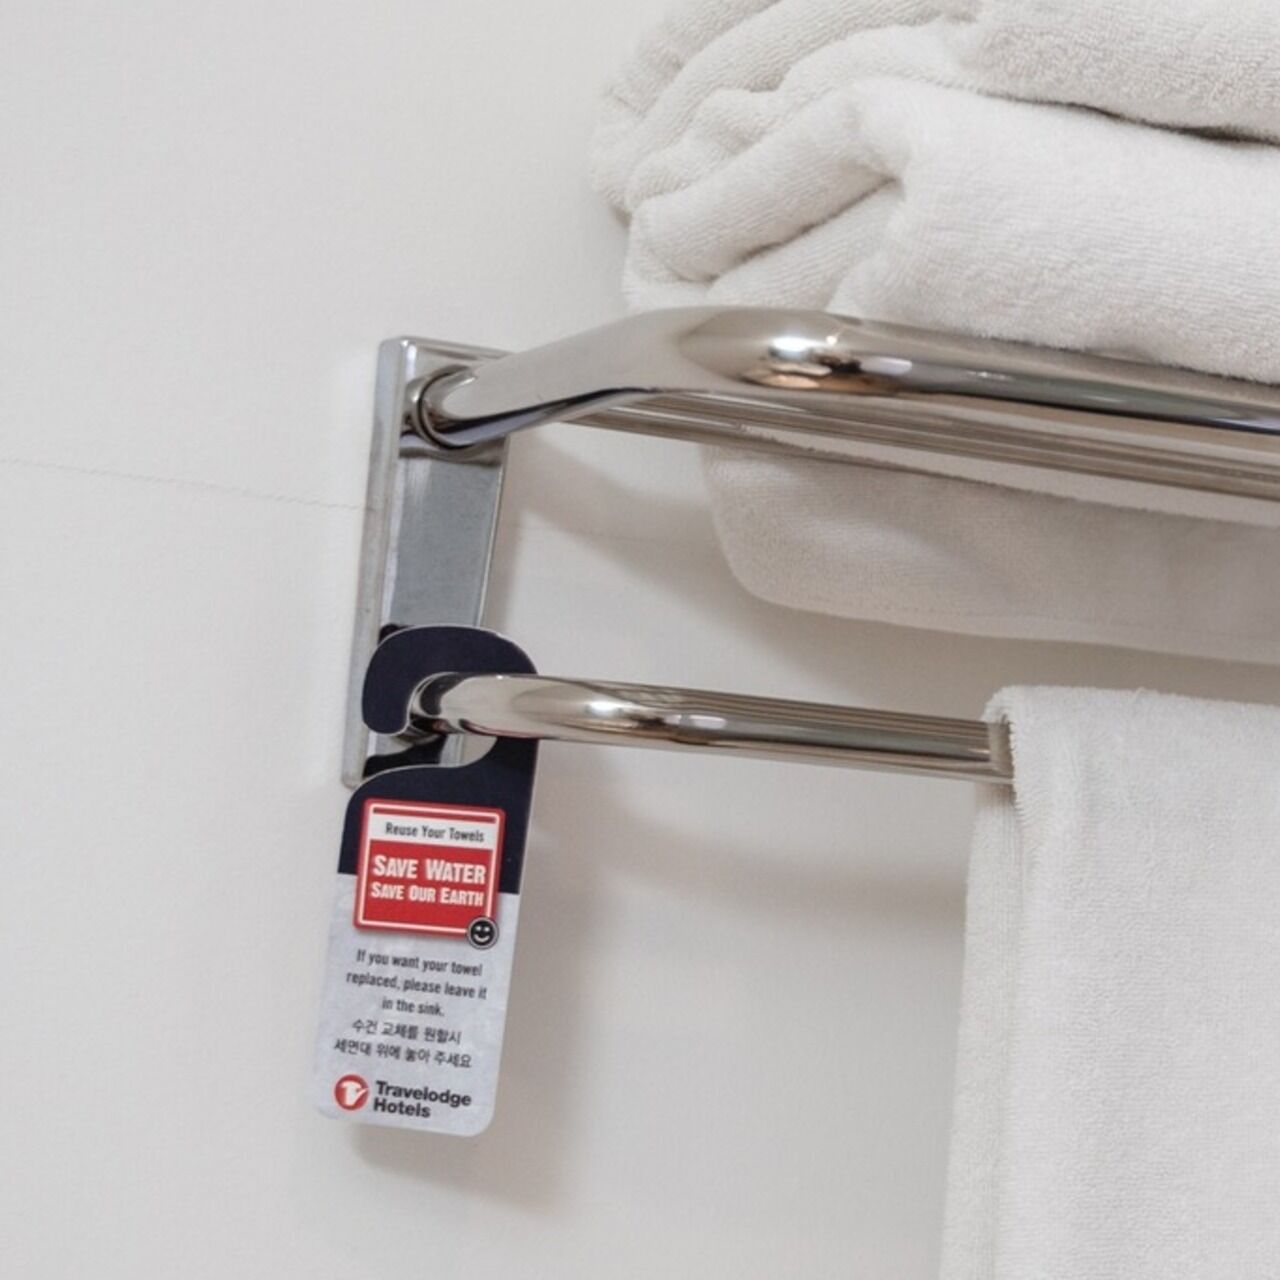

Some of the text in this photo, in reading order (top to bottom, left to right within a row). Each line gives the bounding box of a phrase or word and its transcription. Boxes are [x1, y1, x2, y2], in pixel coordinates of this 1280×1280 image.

[386, 822, 484, 842] Reuse Your Towels
[373, 855, 486, 884] SAVE WATER
[371, 882, 484, 906] SAVE OUR EARTH
[357, 949, 482, 976] If you want your towel
[347, 972, 487, 1000] replaced, please leave it
[382, 997, 444, 1016] in the sink.
[376, 1080, 472, 1107] Travelodge
[373, 1098, 431, 1118] Hotels
